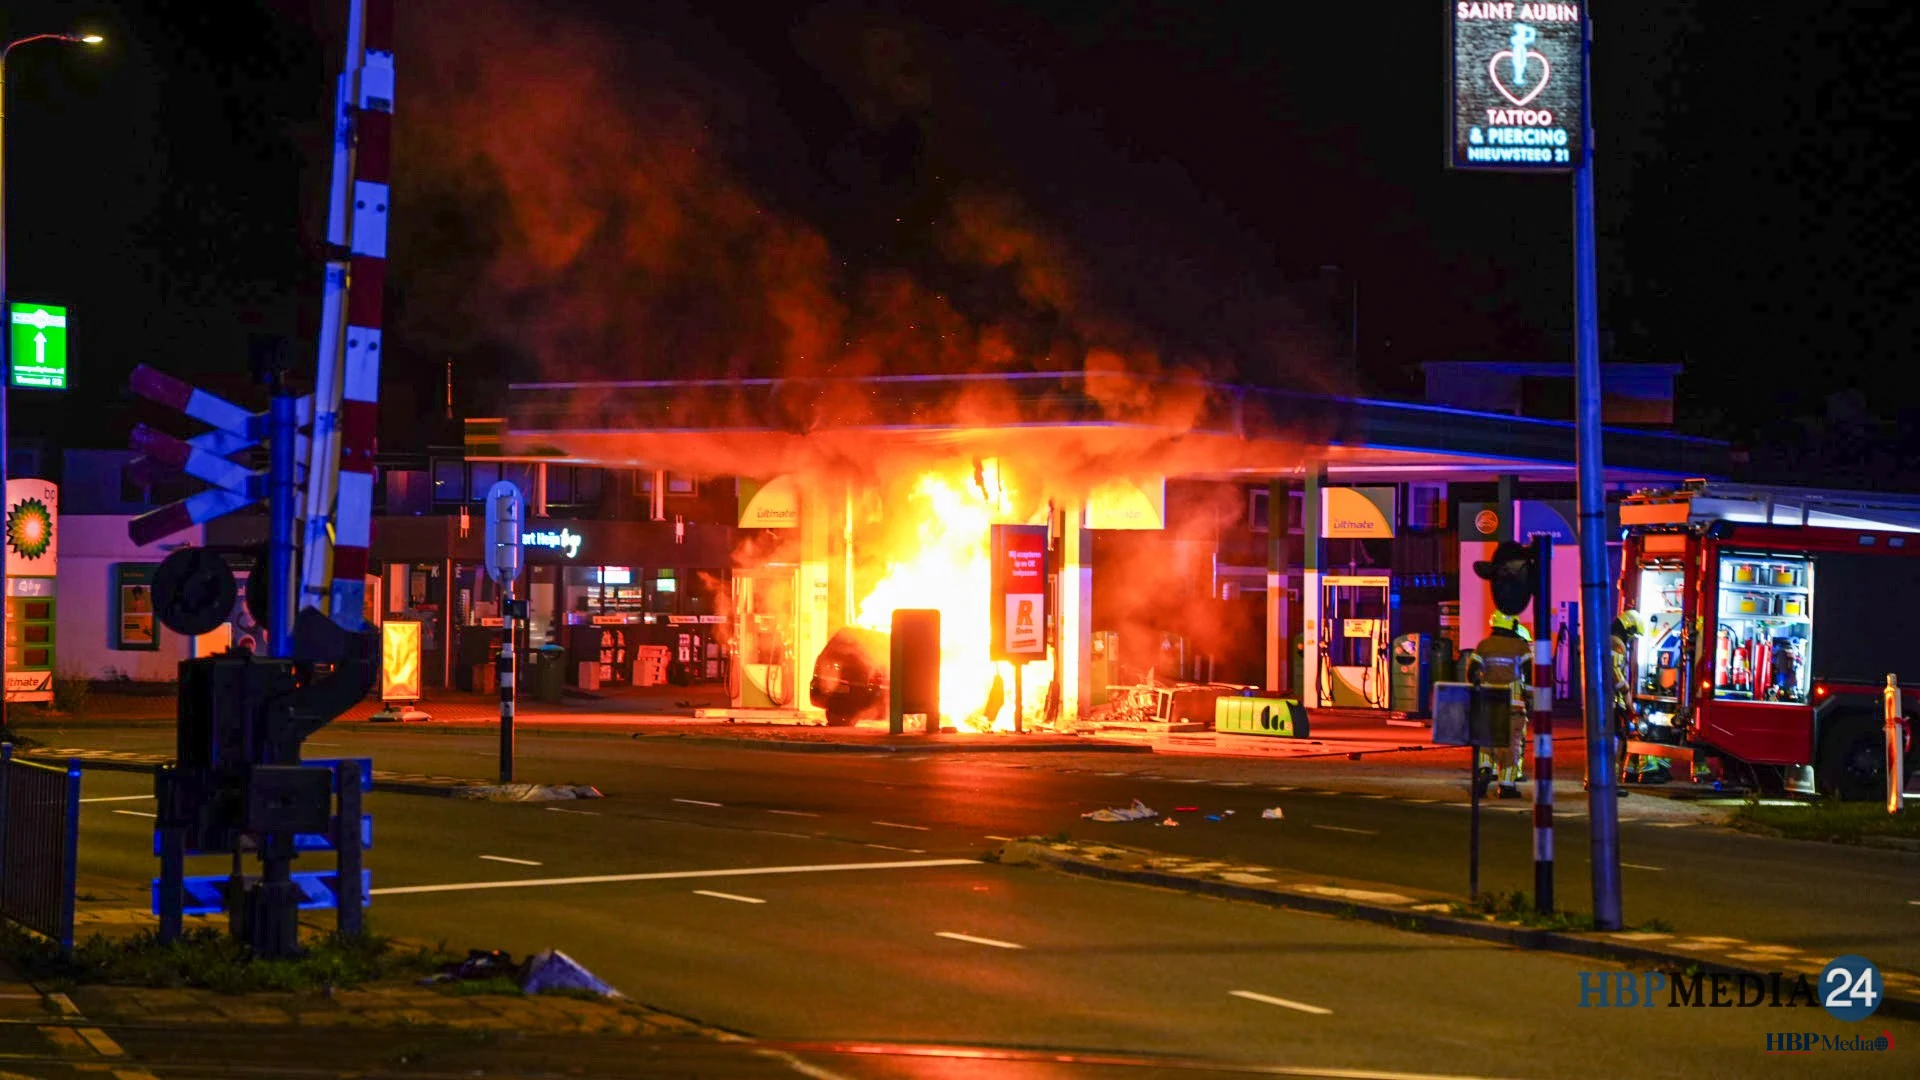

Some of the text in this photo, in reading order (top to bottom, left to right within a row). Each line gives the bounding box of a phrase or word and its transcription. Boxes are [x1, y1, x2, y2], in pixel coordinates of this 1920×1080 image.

[1457, 1, 1579, 21] SAINT AUBIN
[1486, 109, 1553, 126] TATTOO
[1469, 127, 1568, 146] & PIERCING
[1467, 147, 1570, 162] NIEUWSTEEG 21
[44, 487, 56, 502] bp
[1333, 519, 1375, 529] ultimate
[6, 677, 39, 687] ltimate
